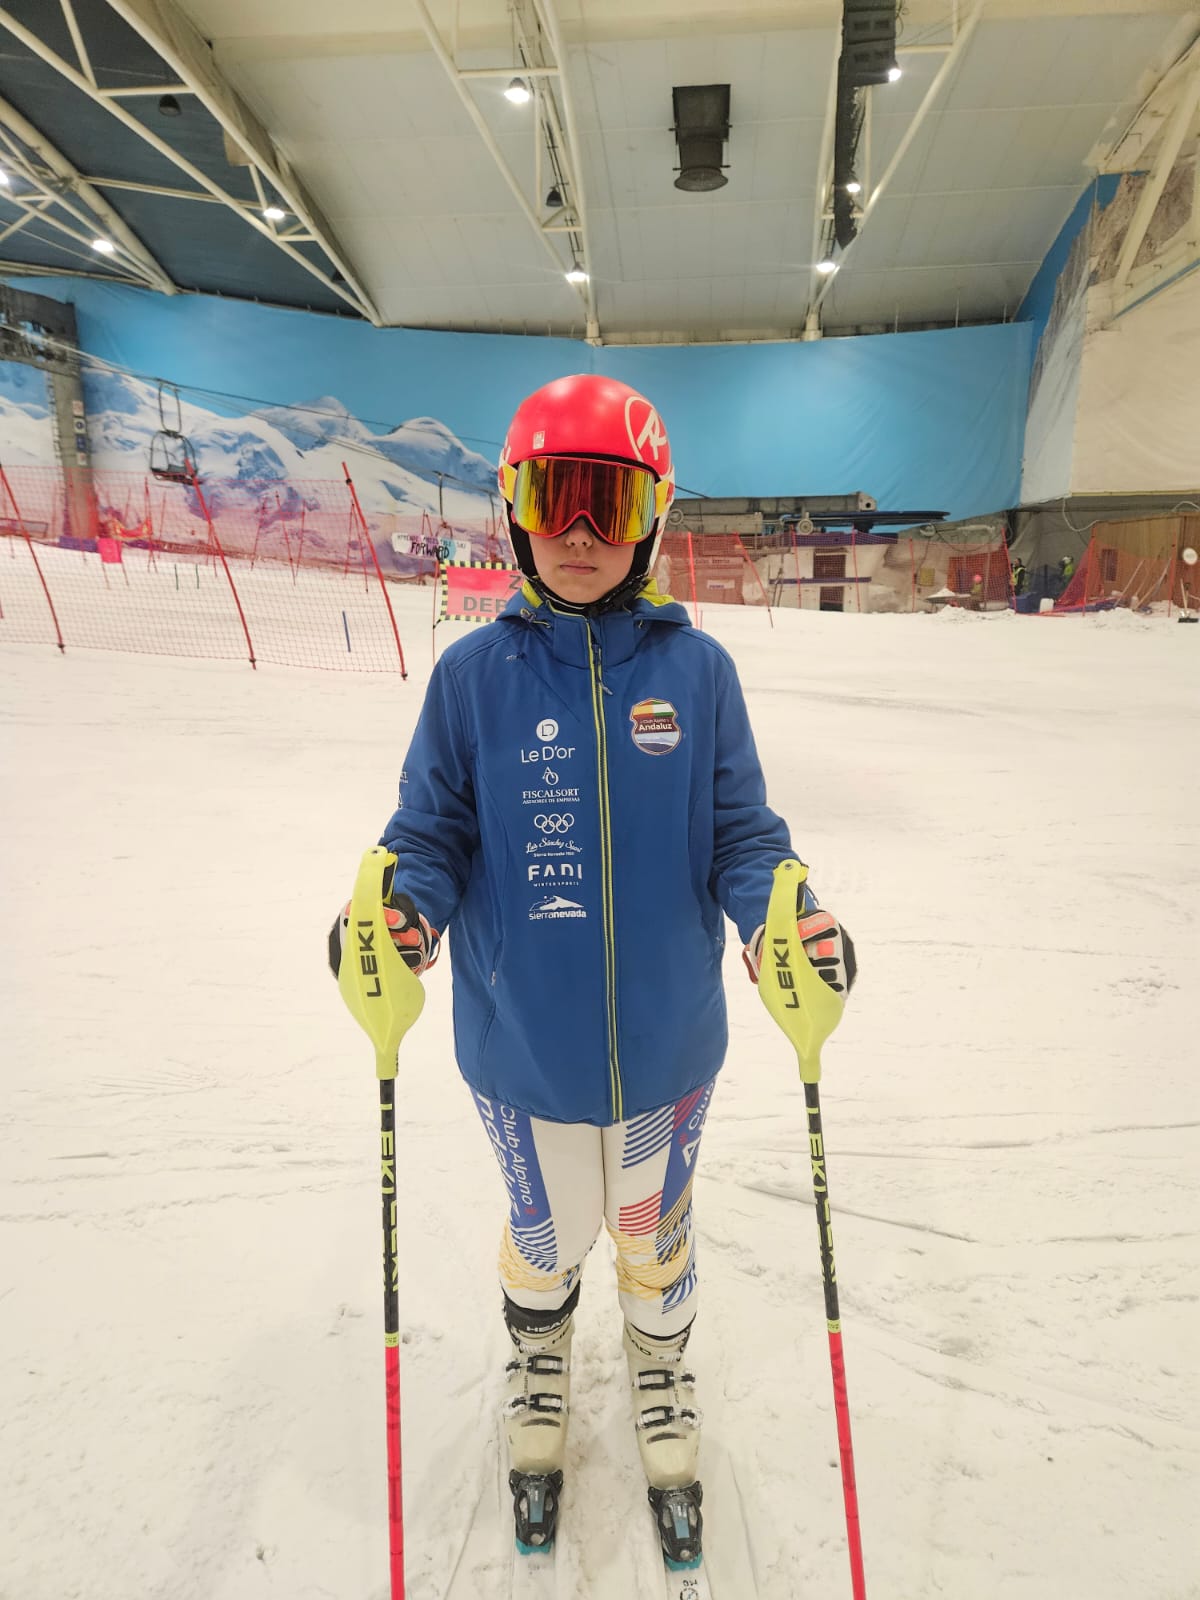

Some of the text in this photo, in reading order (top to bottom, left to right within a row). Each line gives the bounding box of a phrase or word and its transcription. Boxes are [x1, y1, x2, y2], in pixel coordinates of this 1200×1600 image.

[410, 541, 450, 559] FORWARD
[508, 574, 523, 590] Z
[638, 722, 673, 732] Andaluz
[520, 745, 576, 763] Le D'or
[522, 788, 580, 799] FISCALSORT
[528, 863, 583, 882] FADI
[528, 908, 587, 920] sierranevada
[357, 920, 382, 998] LEKI
[773, 937, 800, 1010] LEKI
[500, 1104, 533, 1206] Club Alpino
